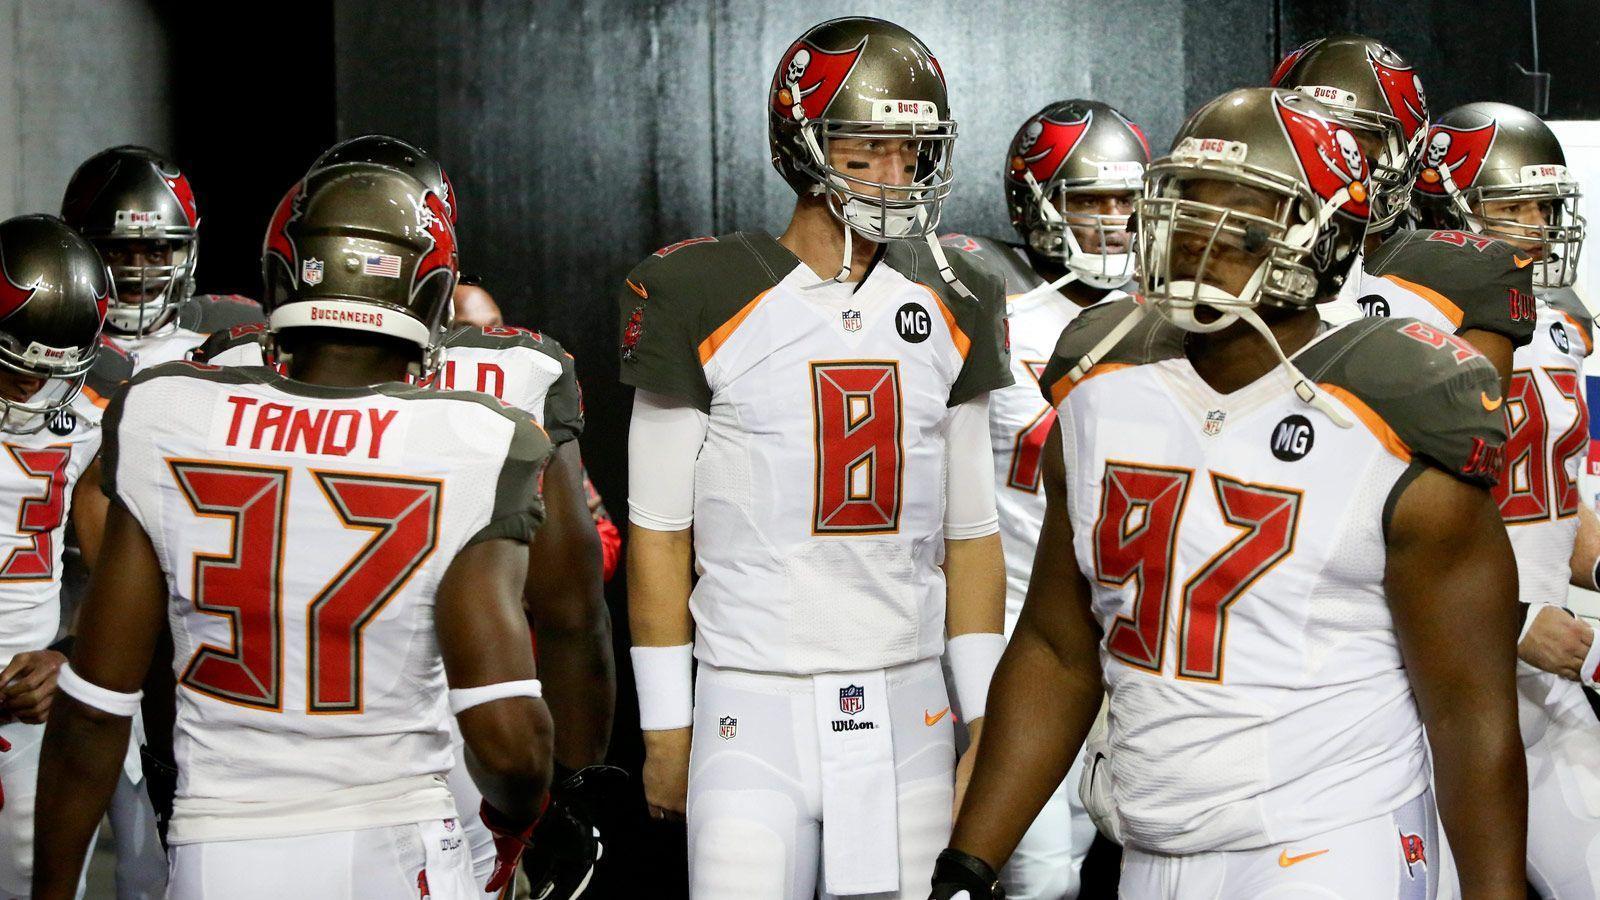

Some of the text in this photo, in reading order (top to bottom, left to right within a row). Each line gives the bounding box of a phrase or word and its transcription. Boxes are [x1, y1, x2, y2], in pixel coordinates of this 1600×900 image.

[306, 270, 321, 282] NFL
[311, 307, 383, 328] BUCCANEERS
[844, 317, 861, 331] NFL
[901, 309, 928, 336] MG
[227, 395, 399, 460] TANDY
[1204, 419, 1219, 434] NFL
[809, 360, 905, 537] 8
[1277, 423, 1308, 456] MG
[1491, 366, 1591, 527] 82
[1092, 458, 1305, 686] 97
[165, 457, 445, 716] 37
[842, 698, 861, 712] NFL
[721, 725, 735, 738] NFL
[832, 719, 874, 732] Wilson
